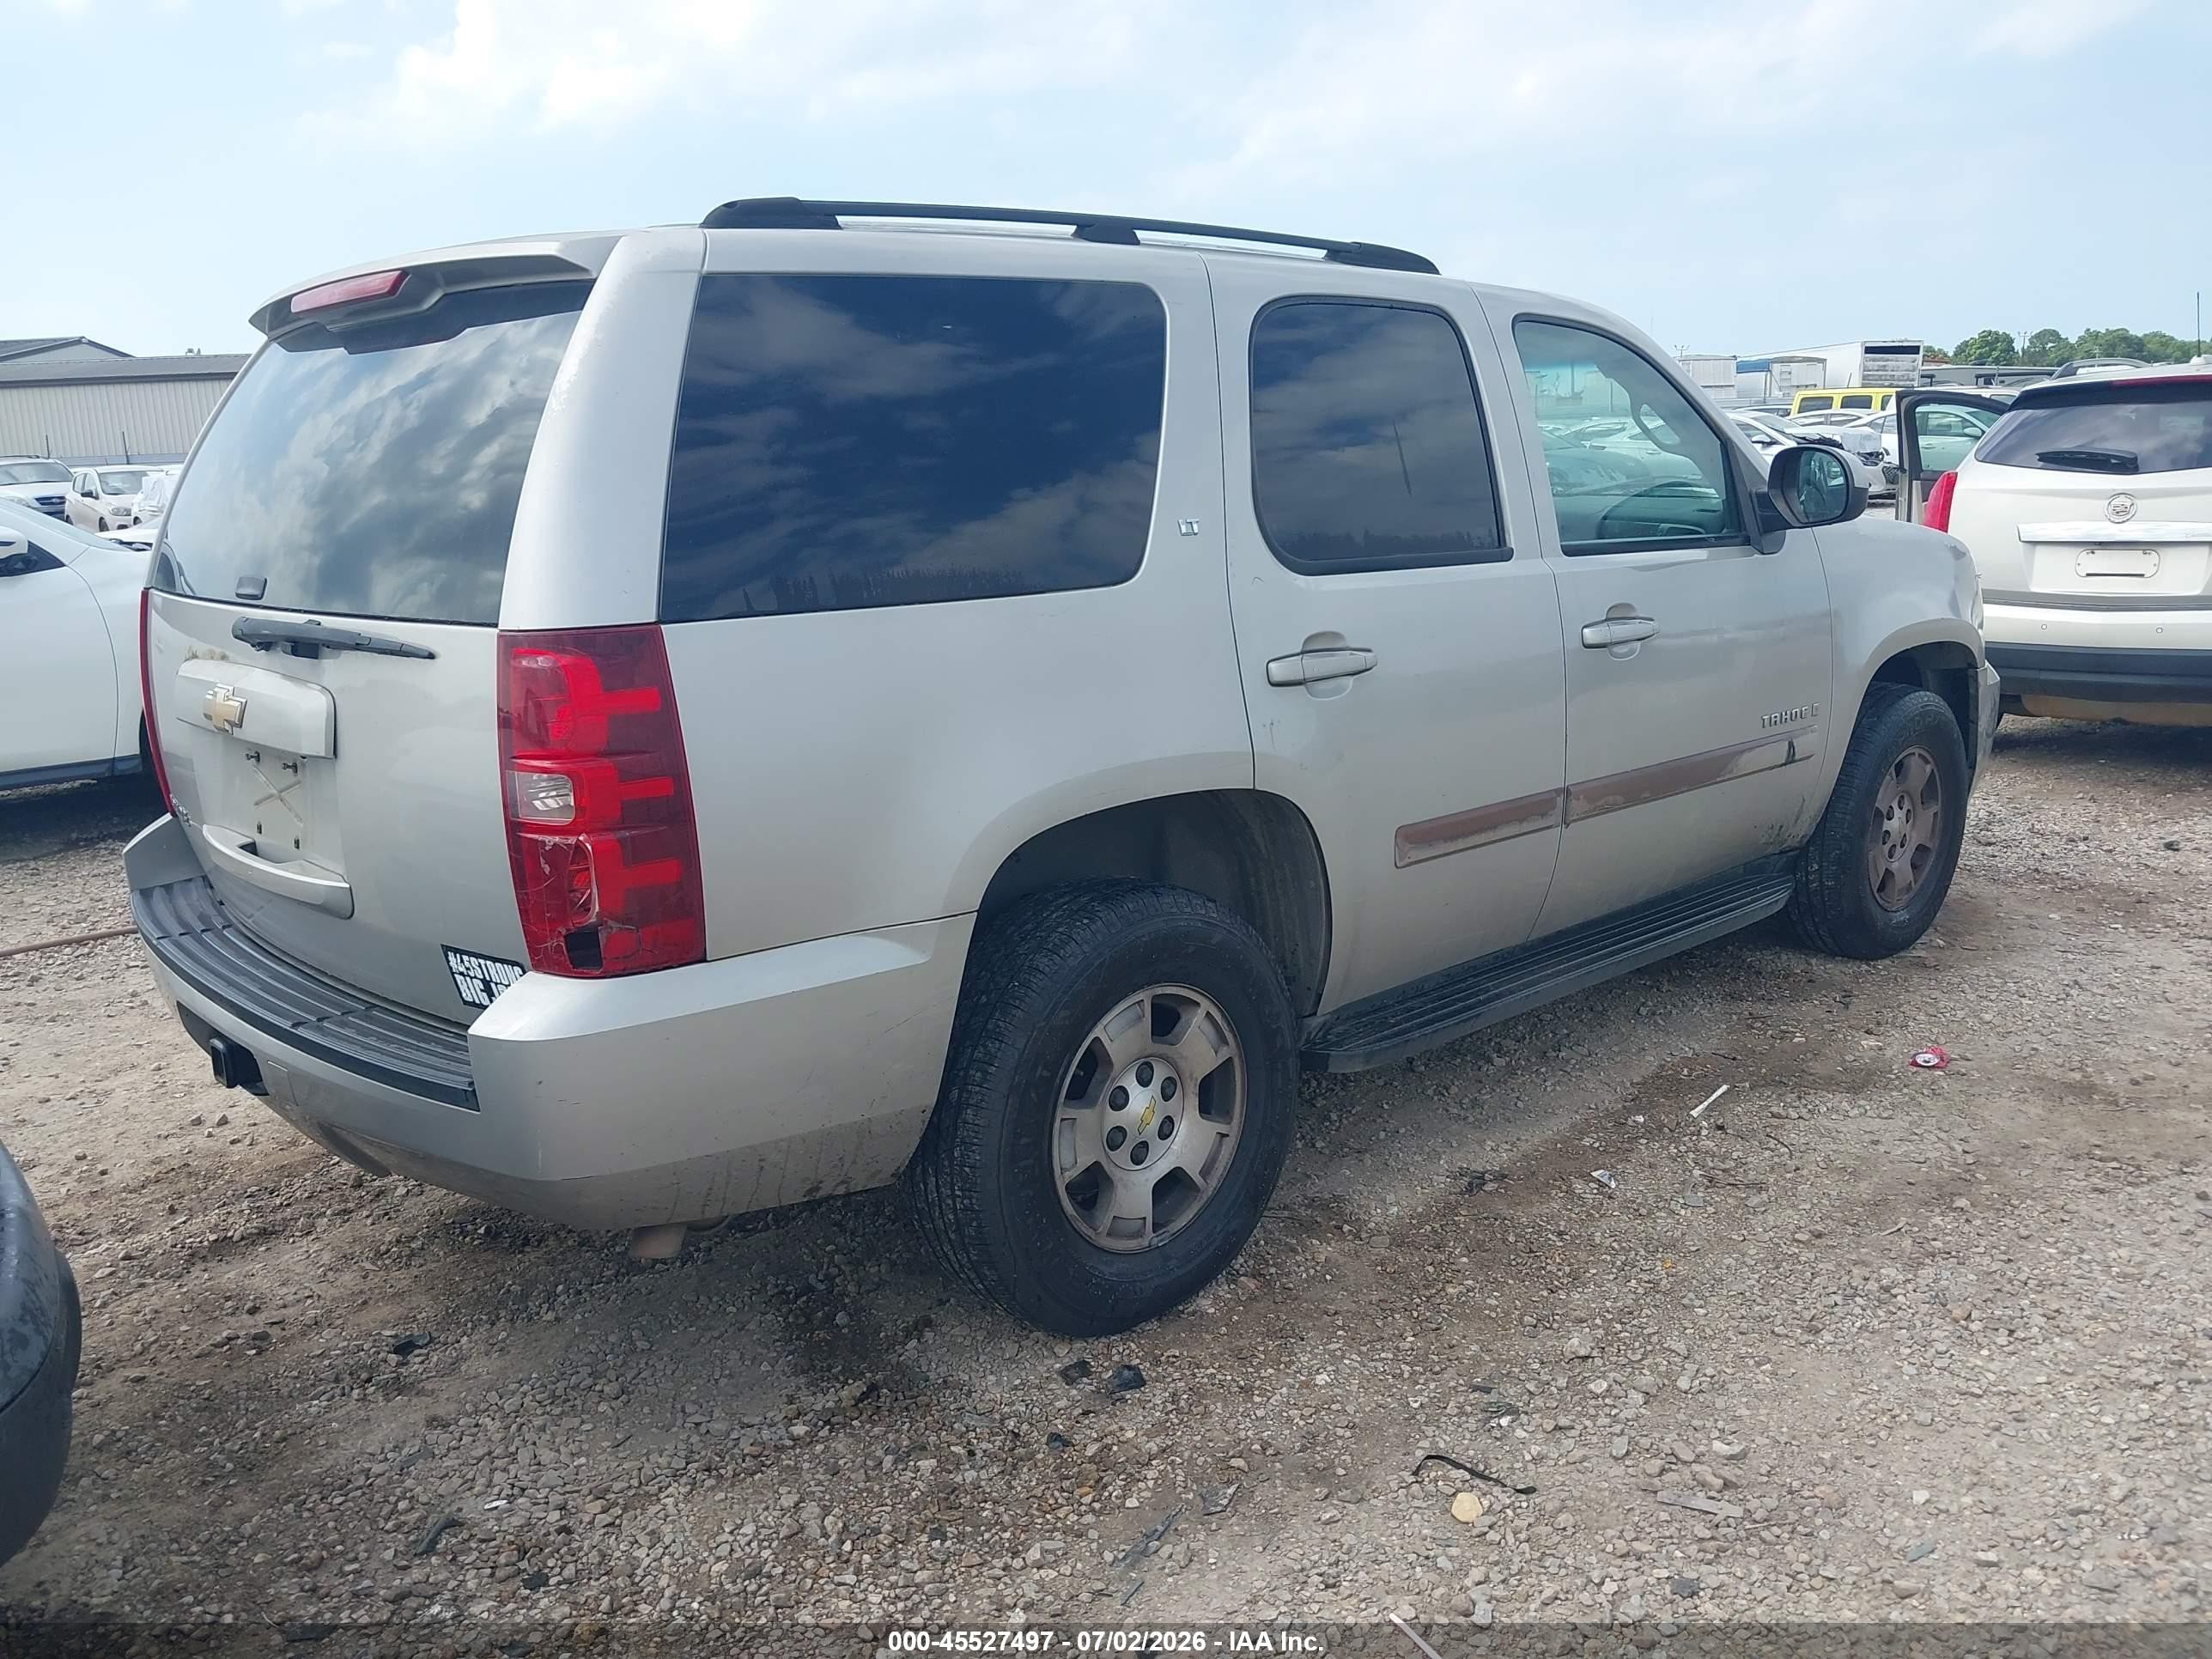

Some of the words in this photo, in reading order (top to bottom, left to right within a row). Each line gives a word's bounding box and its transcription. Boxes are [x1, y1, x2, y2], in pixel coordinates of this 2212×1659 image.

[1176, 519, 1200, 536] LT
[1761, 706, 1808, 728] TAHOE
[453, 974, 490, 1006] BIG
